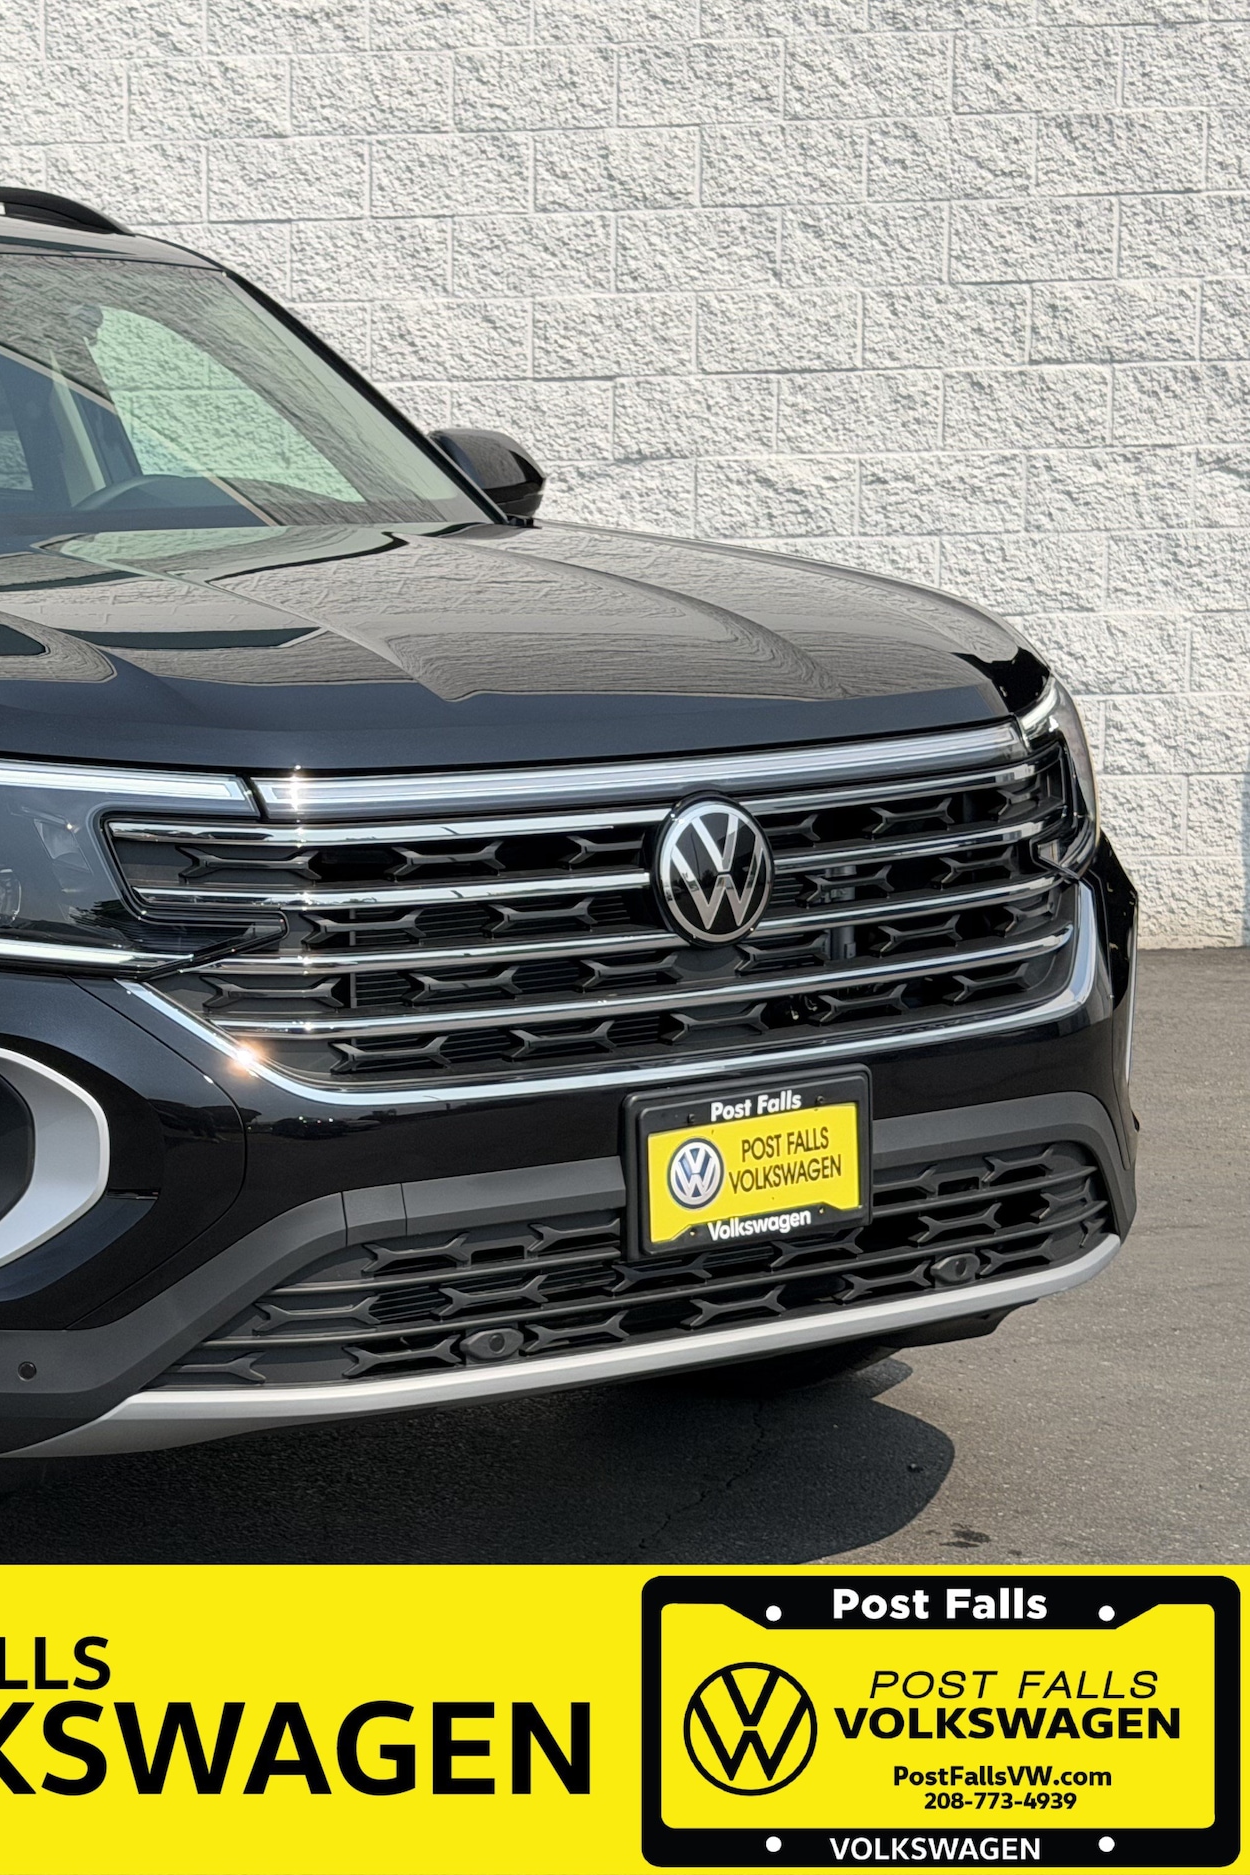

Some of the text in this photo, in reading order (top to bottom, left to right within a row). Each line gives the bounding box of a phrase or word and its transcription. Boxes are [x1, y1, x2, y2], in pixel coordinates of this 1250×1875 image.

[660, 801, 771, 942] VW
[711, 1090, 802, 1122] Post Falls
[741, 1126, 829, 1163] POST FALLS
[728, 1153, 842, 1194] VOLKSWAGEN
[707, 1210, 811, 1241] Volkswagen
